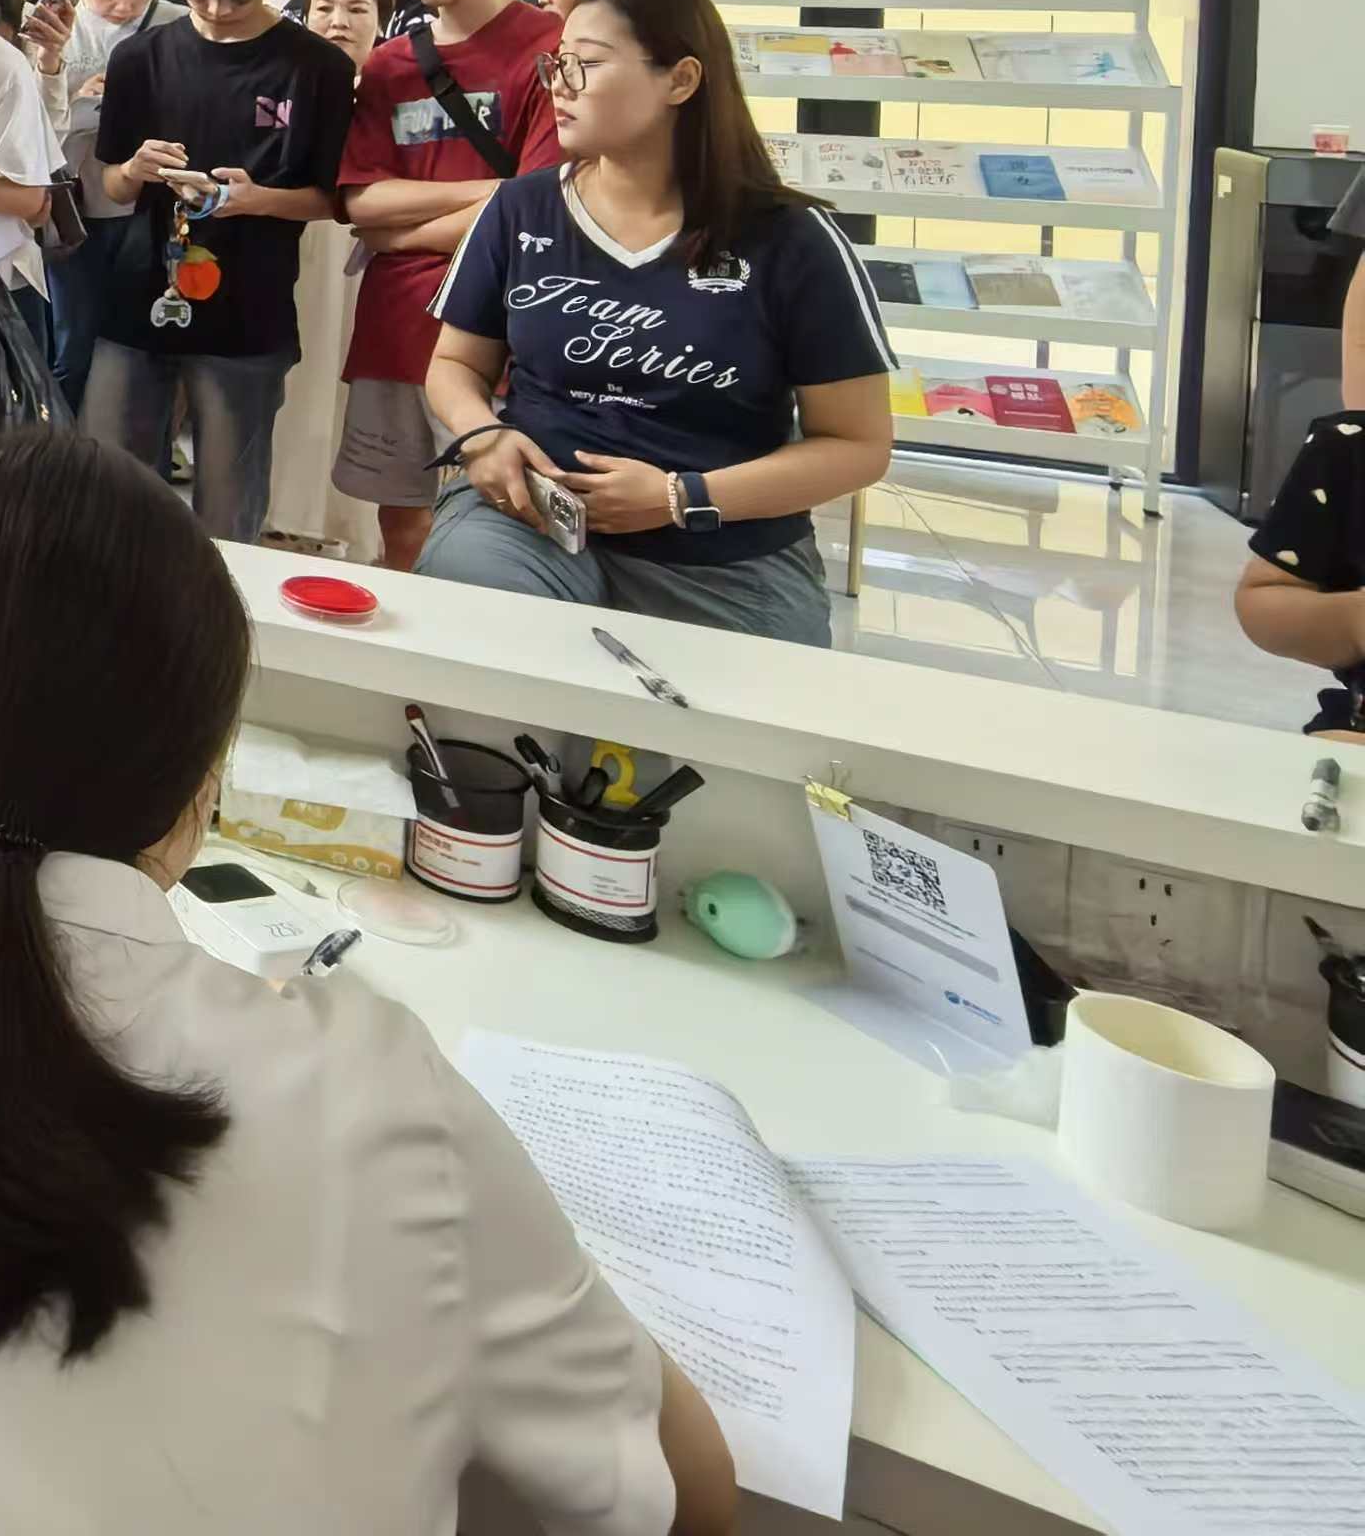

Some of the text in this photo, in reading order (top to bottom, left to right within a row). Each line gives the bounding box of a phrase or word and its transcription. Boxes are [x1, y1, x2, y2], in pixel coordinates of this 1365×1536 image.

[507, 275, 668, 331] Team
[564, 323, 740, 389] Series
[569, 389, 596, 403] very
